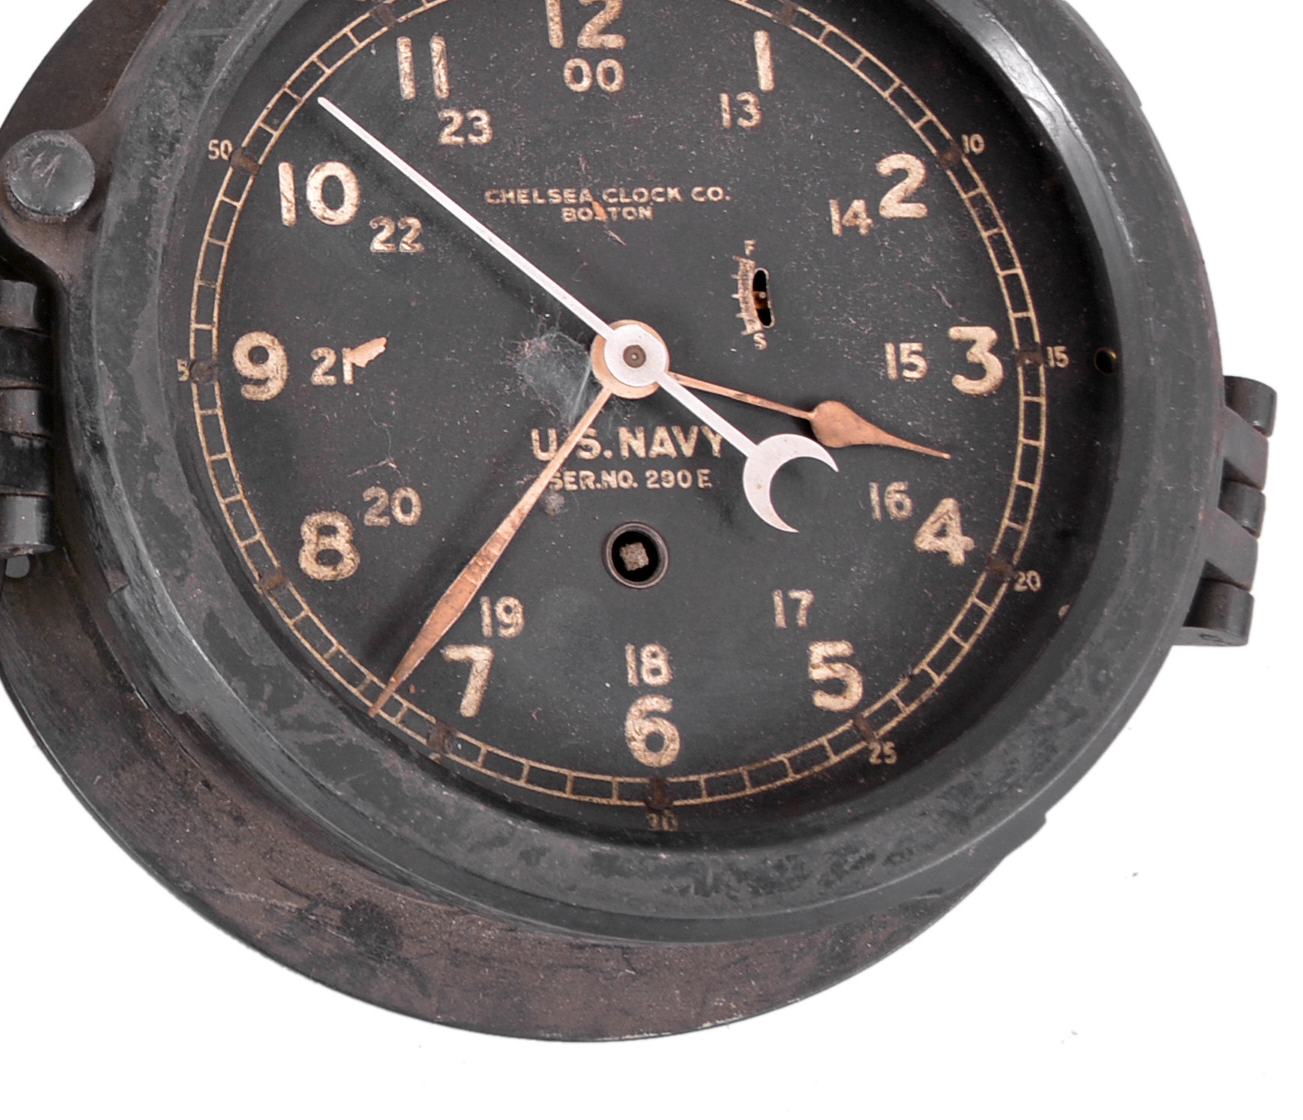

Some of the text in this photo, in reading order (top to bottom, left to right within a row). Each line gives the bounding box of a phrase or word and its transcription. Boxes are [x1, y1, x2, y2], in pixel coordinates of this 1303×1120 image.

[564, 58, 624, 93] 00
[438, 109, 492, 145] 23
[962, 134, 984, 154] 10
[208, 139, 233, 161] 50
[278, 160, 360, 227] 10
[485, 186, 730, 205] CHELSEA CLOCK CO.
[562, 207, 653, 222] BOTON
[829, 199, 873, 236] 14
[744, 240, 756, 255] F
[753, 332, 766, 350] S
[1046, 346, 1069, 369] 15
[232, 331, 288, 401] 9
[885, 342, 928, 380] 15
[949, 326, 1004, 395] 3
[618, 426, 725, 459] NAVY
[362, 486, 422, 527] 20
[869, 481, 913, 521] 16
[1014, 570, 1041, 593] 20
[480, 596, 525, 638] 19
[625, 642, 672, 686] 18
[625, 694, 680, 767] 6
[868, 742, 897, 765] 25
